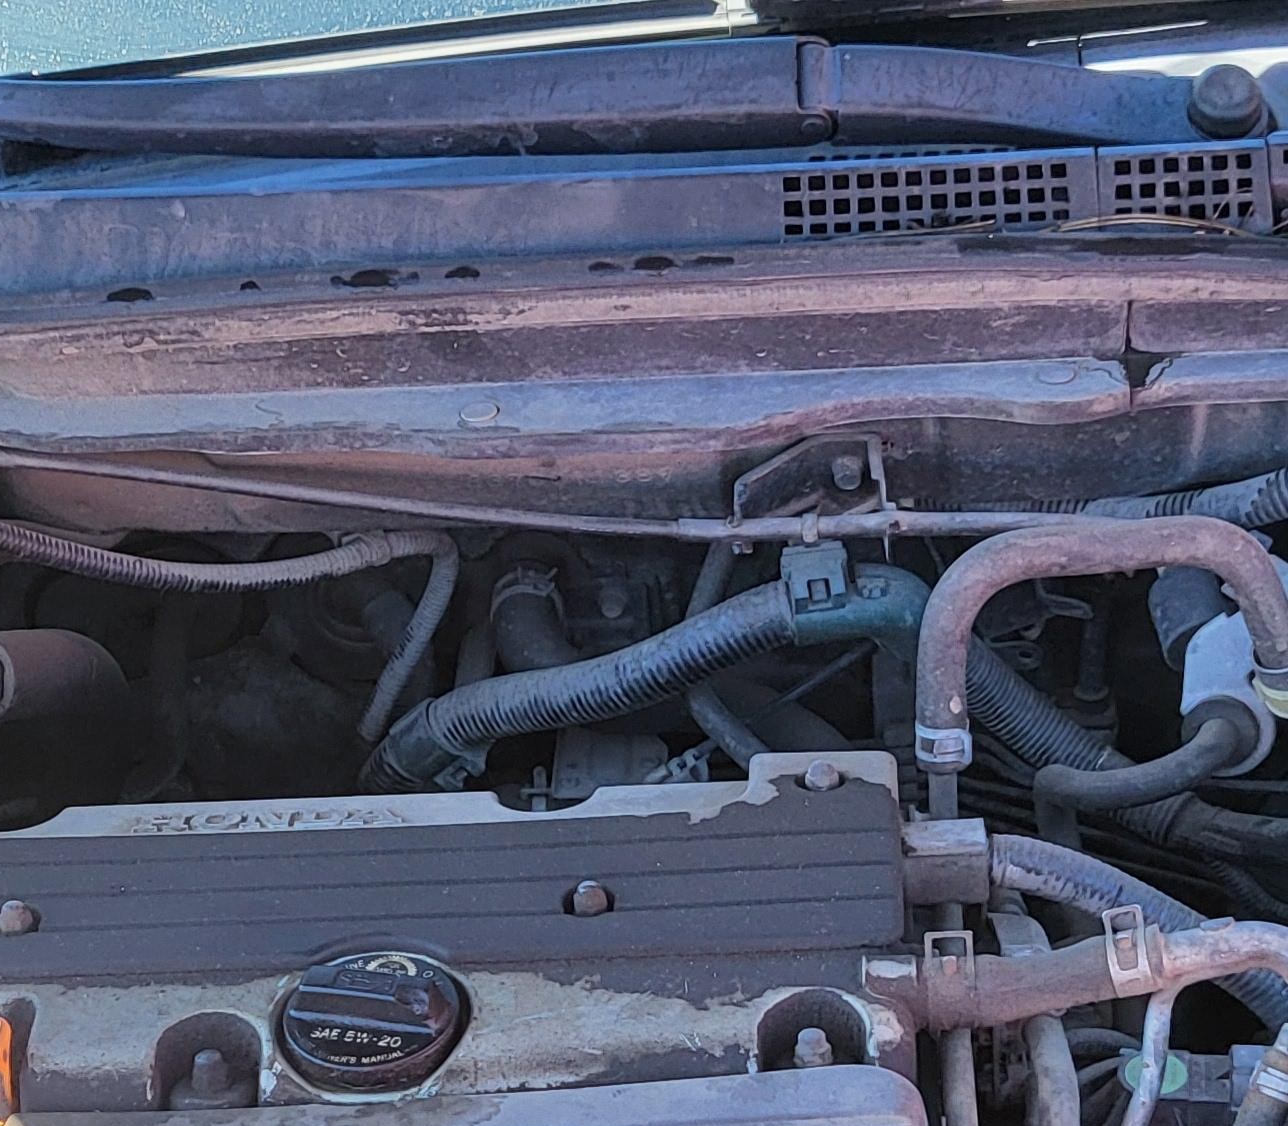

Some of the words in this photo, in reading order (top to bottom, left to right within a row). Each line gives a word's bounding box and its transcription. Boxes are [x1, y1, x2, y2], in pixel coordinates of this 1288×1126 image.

[131, 808, 404, 833] HONDA
[310, 1027, 341, 1040] SAE
[343, 1030, 402, 1048] 5W-20
